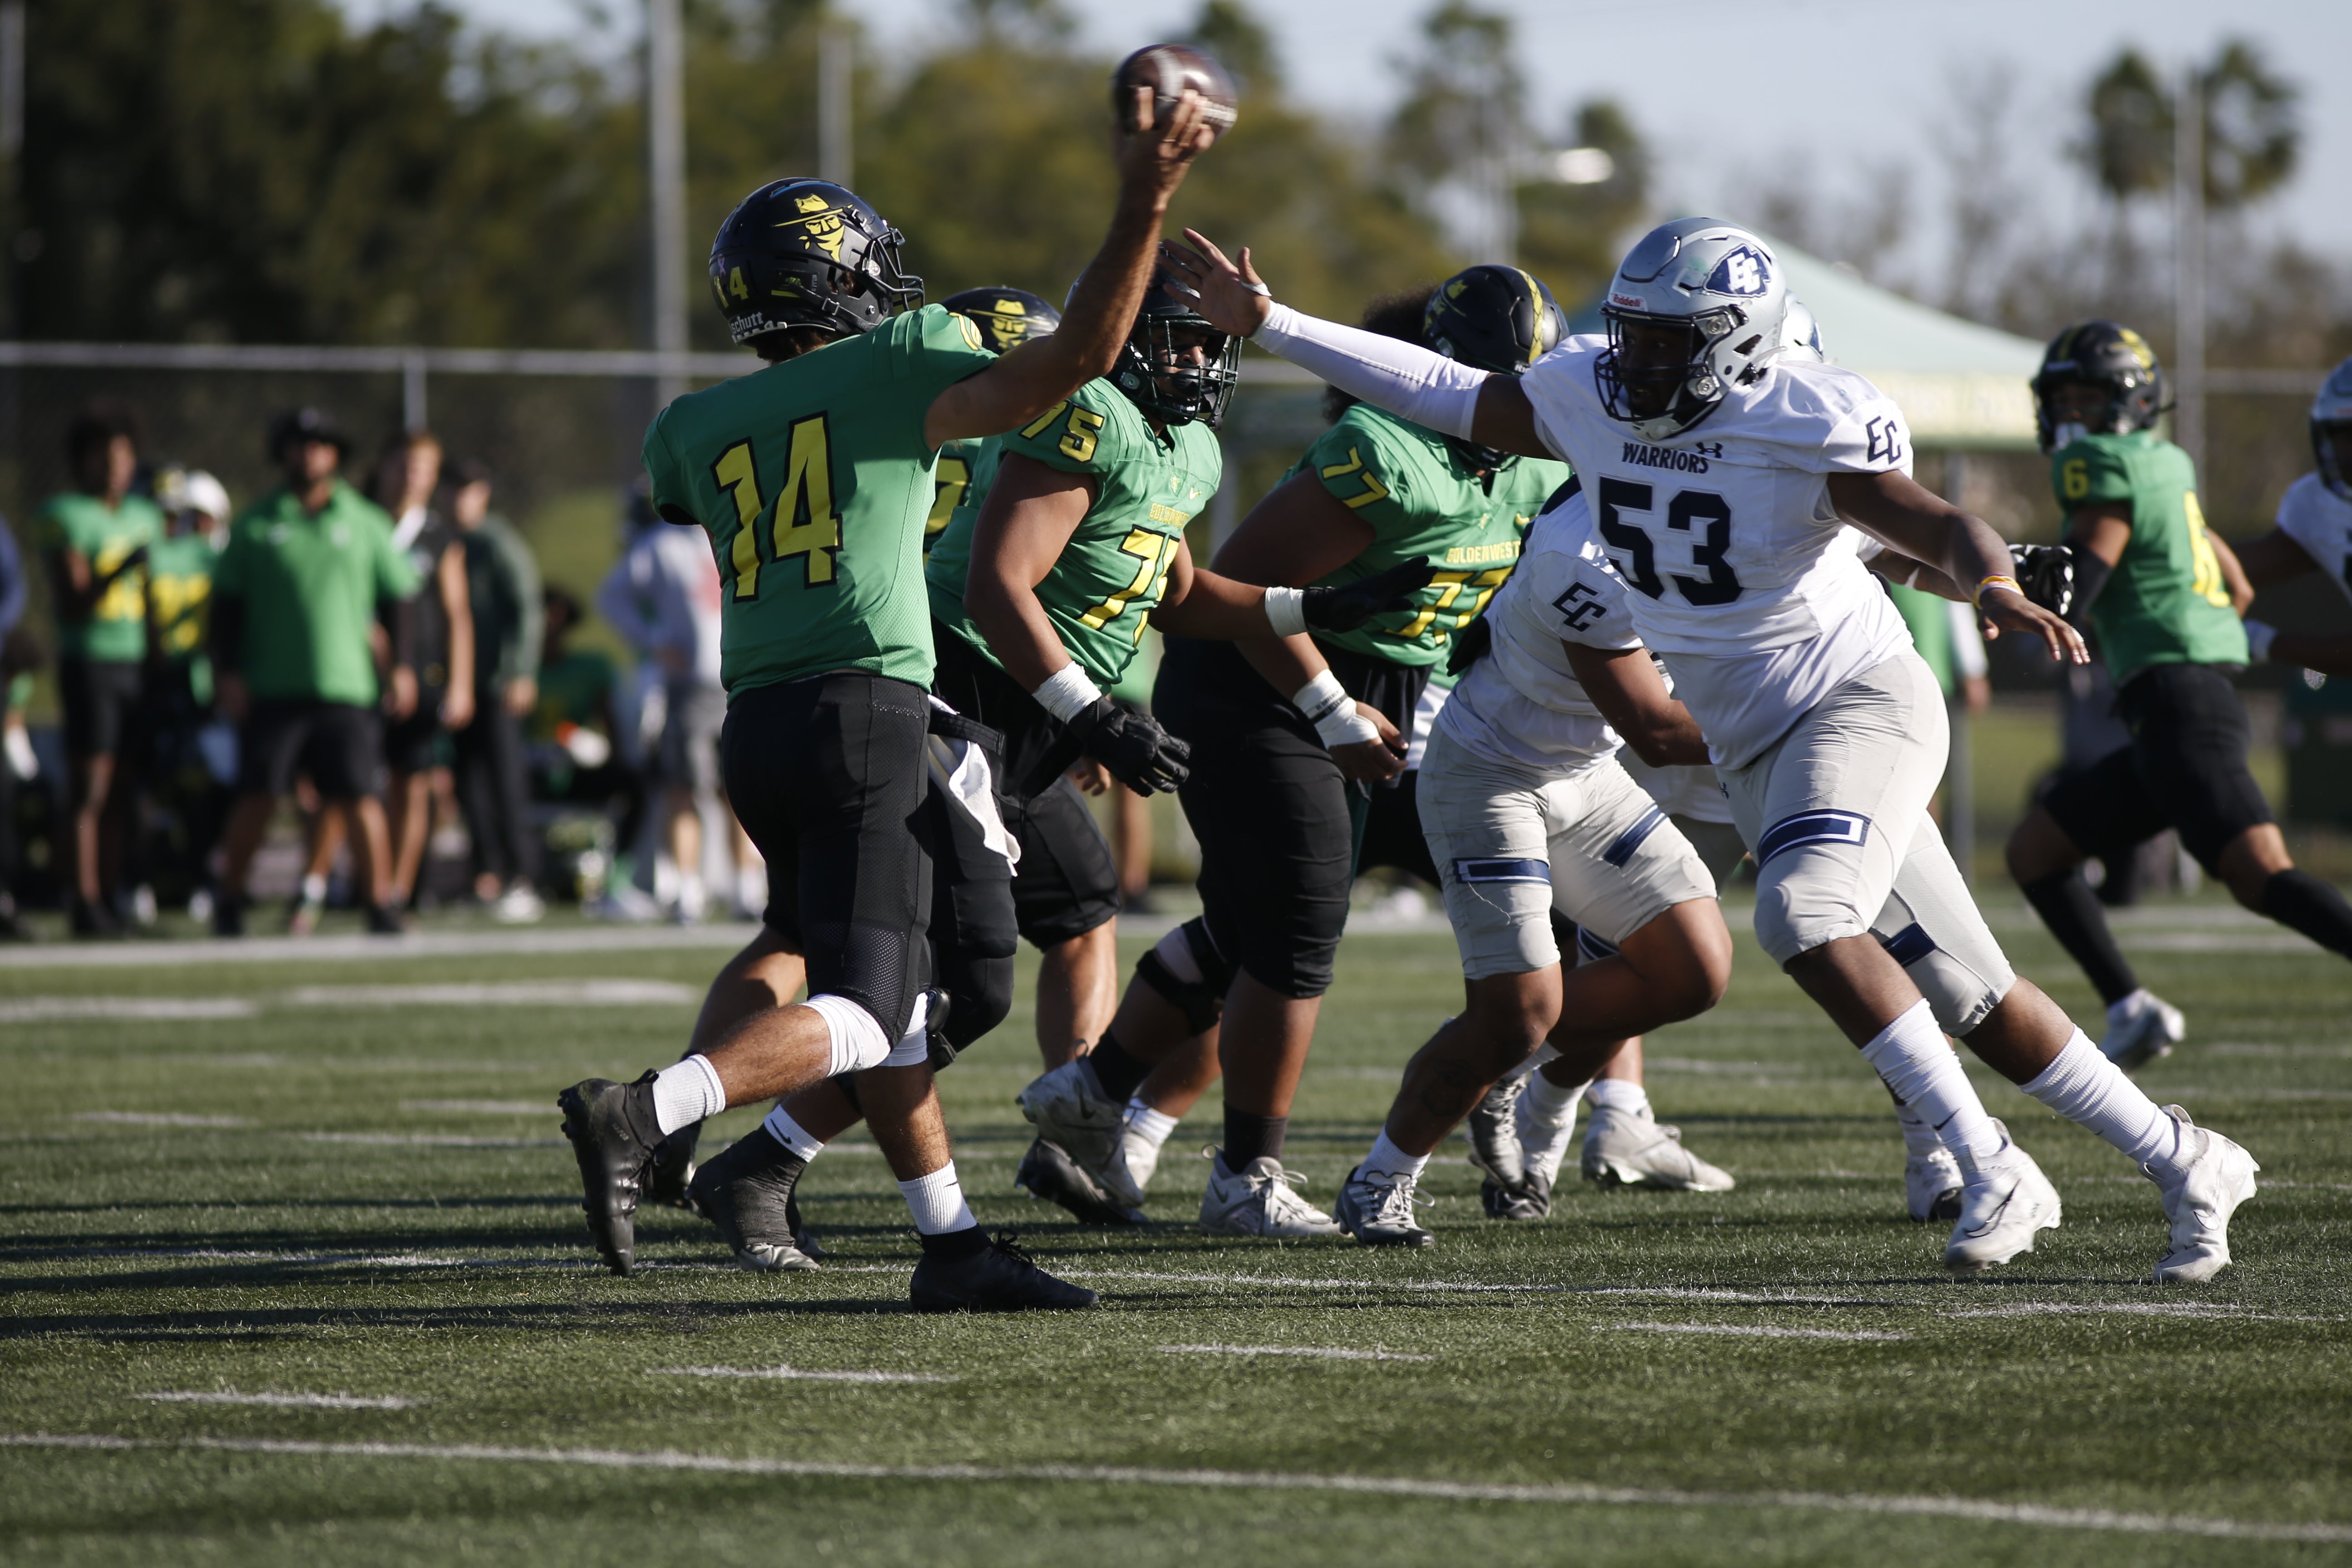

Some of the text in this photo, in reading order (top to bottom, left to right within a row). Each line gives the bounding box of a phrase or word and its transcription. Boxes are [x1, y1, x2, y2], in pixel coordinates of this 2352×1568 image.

[1726, 252, 1761, 294] EC
[730, 311, 764, 334] schutt
[1621, 442, 1709, 475] WARRIORS
[1866, 416, 1901, 465] EC
[1320, 444, 1391, 510] 77
[2063, 459, 2089, 499] 6
[710, 409, 843, 604] 14
[1446, 540, 1521, 564] GOLDENWEST
[1597, 475, 1745, 608] 53
[1551, 581, 1607, 632] EC
